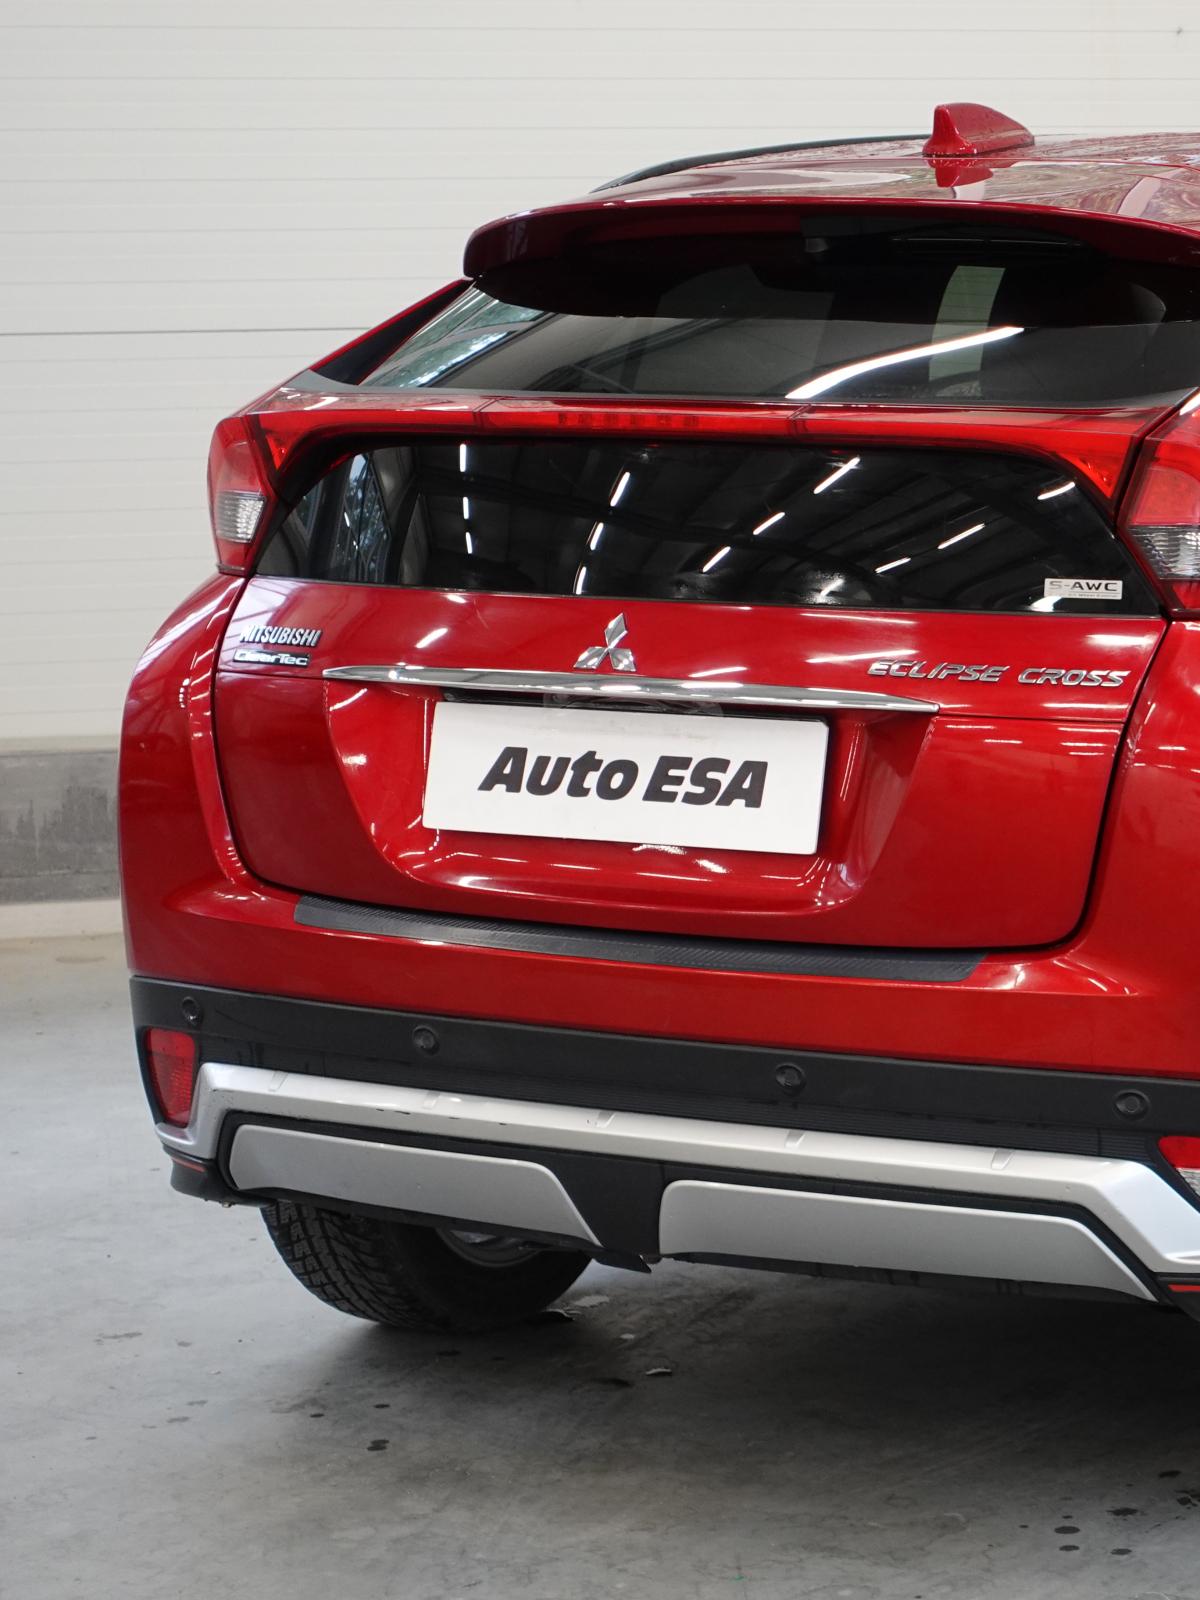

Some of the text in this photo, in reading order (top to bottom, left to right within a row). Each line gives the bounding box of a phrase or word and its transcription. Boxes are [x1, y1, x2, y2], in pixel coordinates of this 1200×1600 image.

[1049, 580, 1118, 592] S-AWC
[240, 624, 322, 647] MITSUBISHI
[867, 658, 1132, 688] ECLIPSE CROSS
[478, 746, 768, 808] Auto ESA
